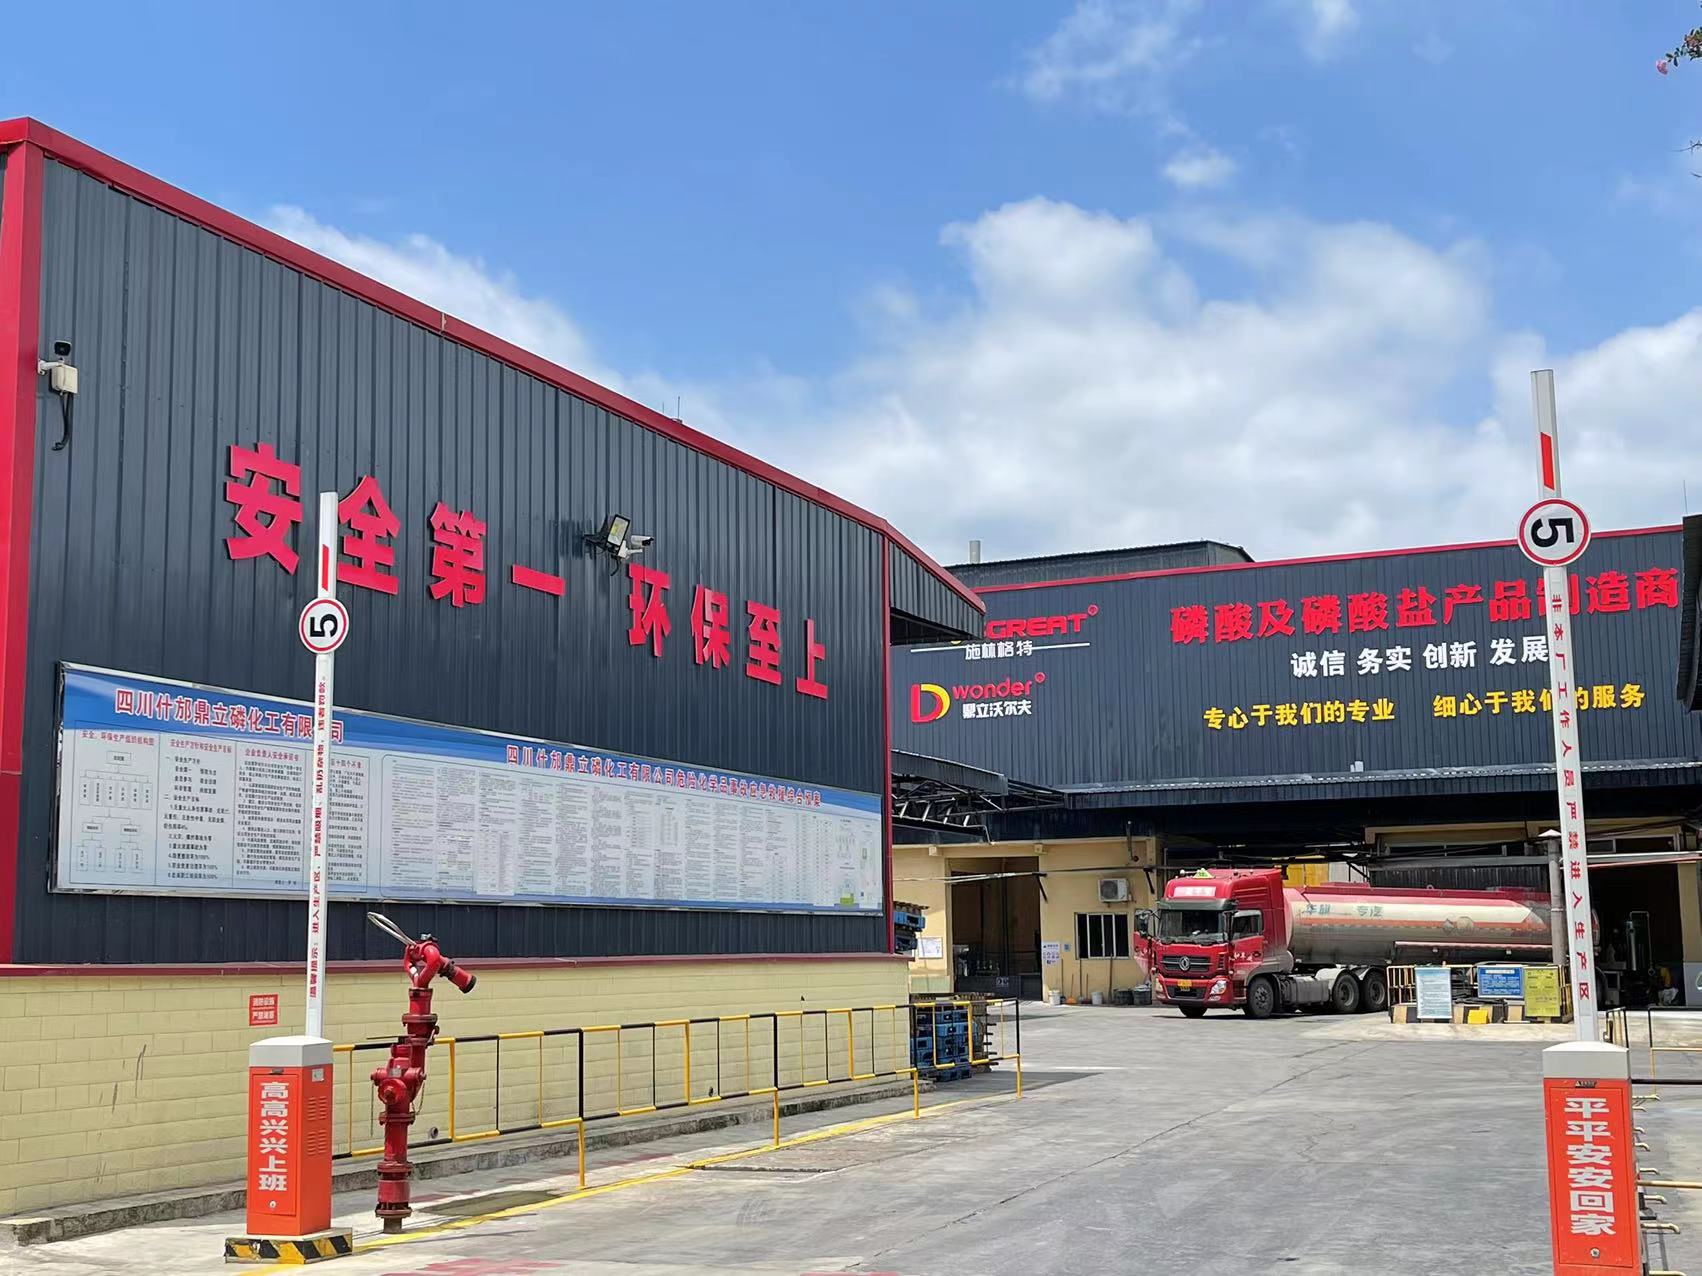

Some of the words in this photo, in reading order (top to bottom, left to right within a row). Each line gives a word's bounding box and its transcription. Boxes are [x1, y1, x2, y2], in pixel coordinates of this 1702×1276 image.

[1530, 517, 1575, 548] 5
[310, 613, 338, 638] 5
[965, 640, 1034, 661] 施林格特
[1291, 648, 1347, 679] 诚信
[1357, 645, 1413, 675] 务实
[1422, 640, 1478, 670] 创新
[1489, 634, 1548, 666] 发展
[952, 677, 1033, 700] wonder
[114, 688, 345, 743] 四川什邡鼎立磷化工有限司
[1203, 697, 1396, 731] 专心于我们的专业
[258, 1081, 289, 1192] 高高兴兴上班
[1564, 1097, 1617, 1236] 平平安安回家
